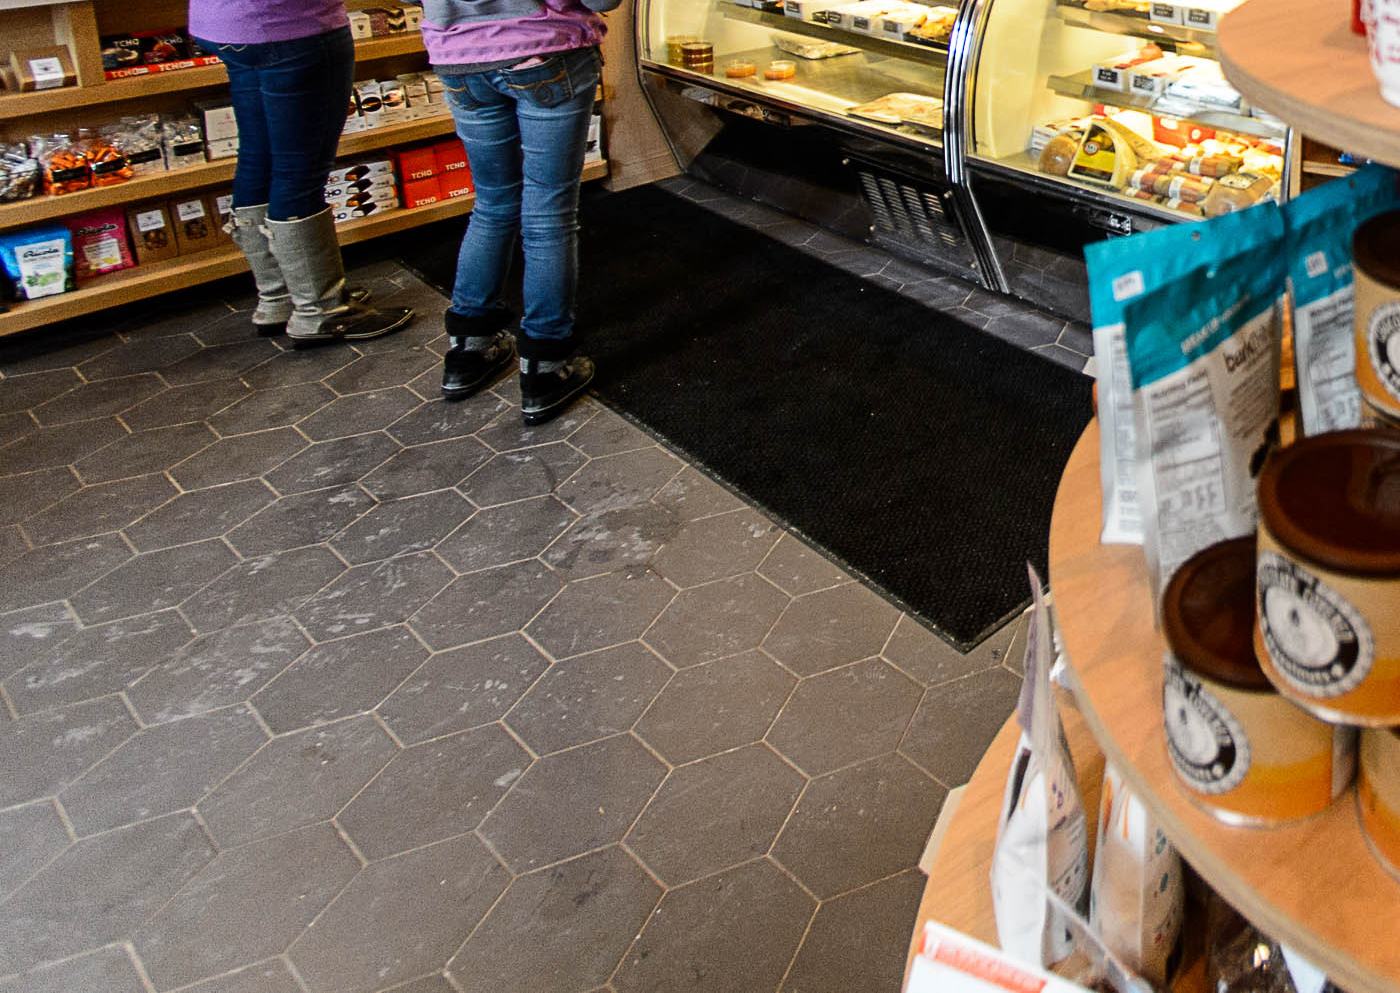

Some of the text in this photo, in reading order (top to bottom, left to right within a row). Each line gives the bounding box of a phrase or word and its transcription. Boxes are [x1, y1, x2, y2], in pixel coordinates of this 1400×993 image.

[112, 38, 140, 48] TCHO
[158, 63, 185, 73] TCHO
[111, 69, 139, 79] TCHO
[445, 161, 466, 171] TCHO
[411, 169, 433, 180] TCHO
[448, 187, 470, 197] TCHO
[415, 196, 437, 207] TCHO
